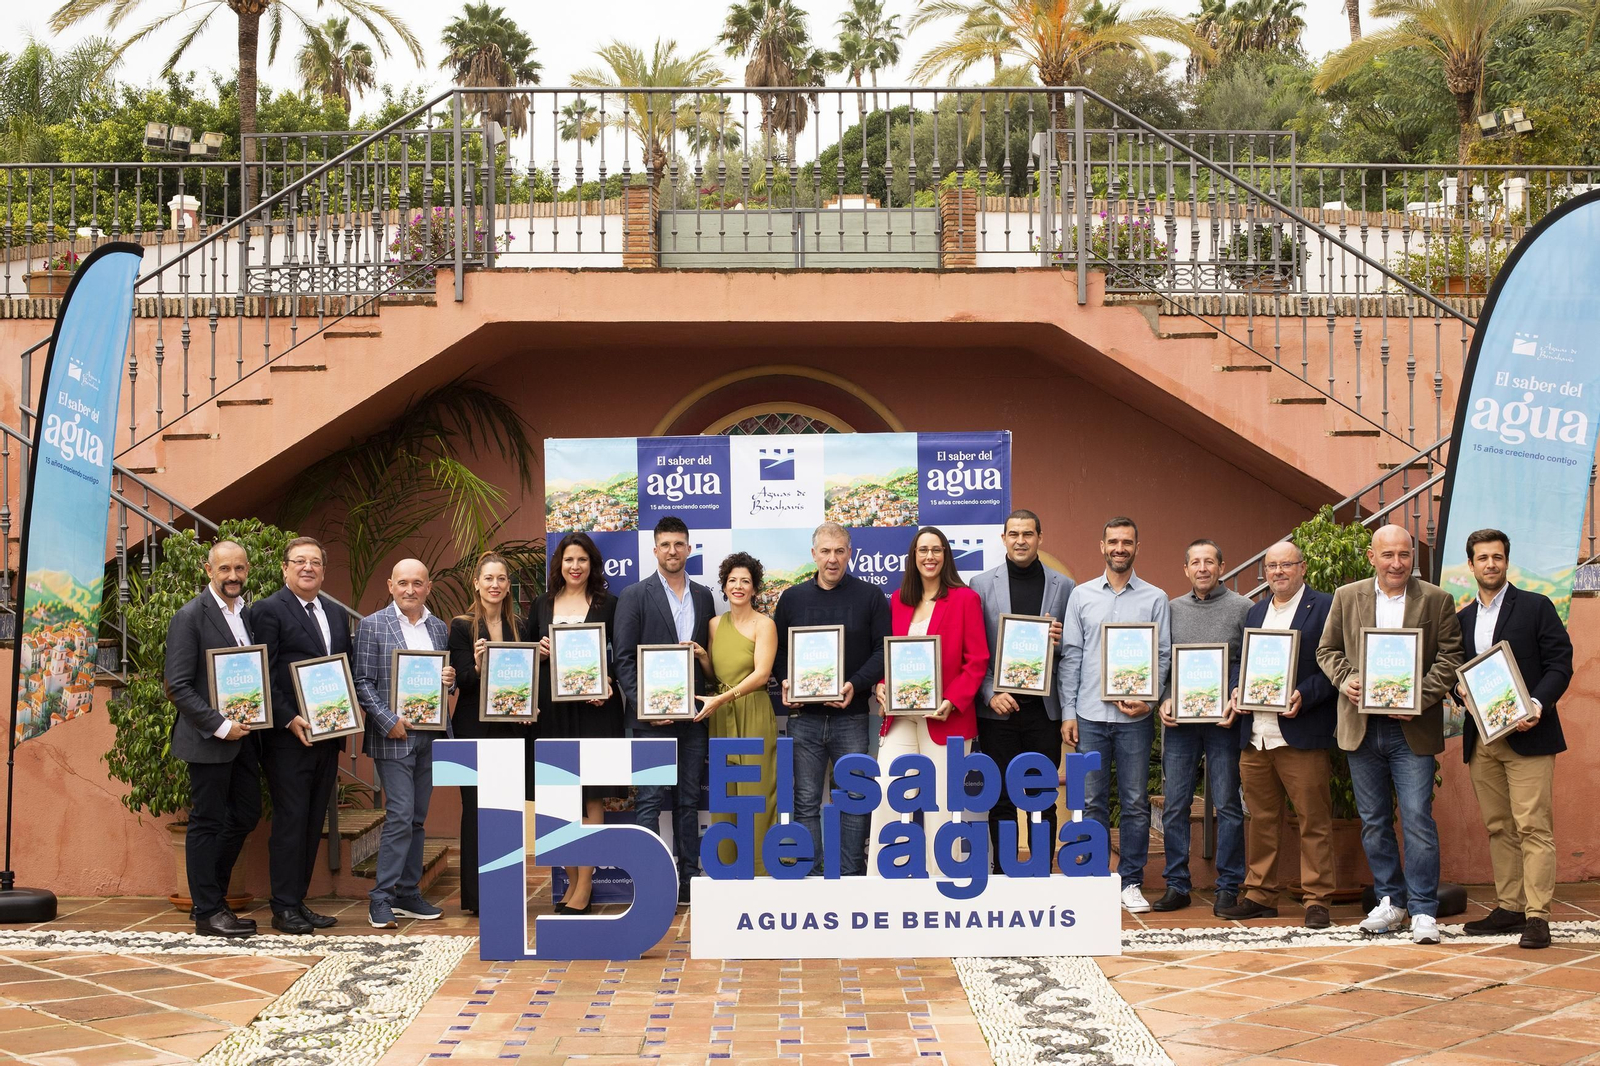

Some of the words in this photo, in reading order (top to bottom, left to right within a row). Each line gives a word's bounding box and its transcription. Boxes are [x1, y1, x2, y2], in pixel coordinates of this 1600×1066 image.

[1495, 371, 1510, 386] El
[1512, 376, 1556, 393] saber
[1560, 381, 1583, 398] del
[58, 391, 68, 406] El
[68, 399, 90, 417] saber
[90, 408, 100, 424] del
[1470, 392, 1588, 446] agua
[44, 413, 104, 467] agua
[657, 456, 666, 466] El
[668, 456, 696, 466] saber
[698, 455, 712, 464] del
[937, 451, 946, 461] El
[948, 450, 976, 460] saber
[978, 450, 992, 460] del
[1473, 444, 1482, 452] 15
[1484, 445, 1504, 454] años
[1505, 448, 1546, 460] creciendo
[1546, 455, 1578, 466] contigo
[45, 456, 50, 464] 15
[51, 460, 63, 470] años
[63, 463, 83, 478] creciendo
[83, 472, 100, 485] contigo
[646, 466, 722, 502] agua
[927, 462, 1002, 497] agua
[752, 486, 790, 502] Aguas
[980, 498, 1000, 506] contigo
[1012, 640, 1038, 652] agua
[1116, 646, 1143, 660] agua
[565, 648, 592, 660] agua
[1255, 654, 1280, 668] agua
[1376, 654, 1406, 668] agua
[497, 668, 524, 680] agua
[652, 668, 679, 680] agua
[900, 660, 926, 674] agua
[1186, 668, 1213, 680] agua
[226, 673, 254, 688] agua
[406, 674, 434, 688] agua
[1479, 676, 1504, 695] agua
[312, 682, 339, 696] agua
[709, 736, 794, 814] El
[831, 736, 1101, 814] saber
[432, 738, 679, 961] 15
[700, 804, 841, 880] del
[877, 818, 1111, 900] agua
[736, 912, 840, 930] AGUAS
[852, 911, 890, 930] DE
[902, 905, 1077, 930] BENAHAVÍS
